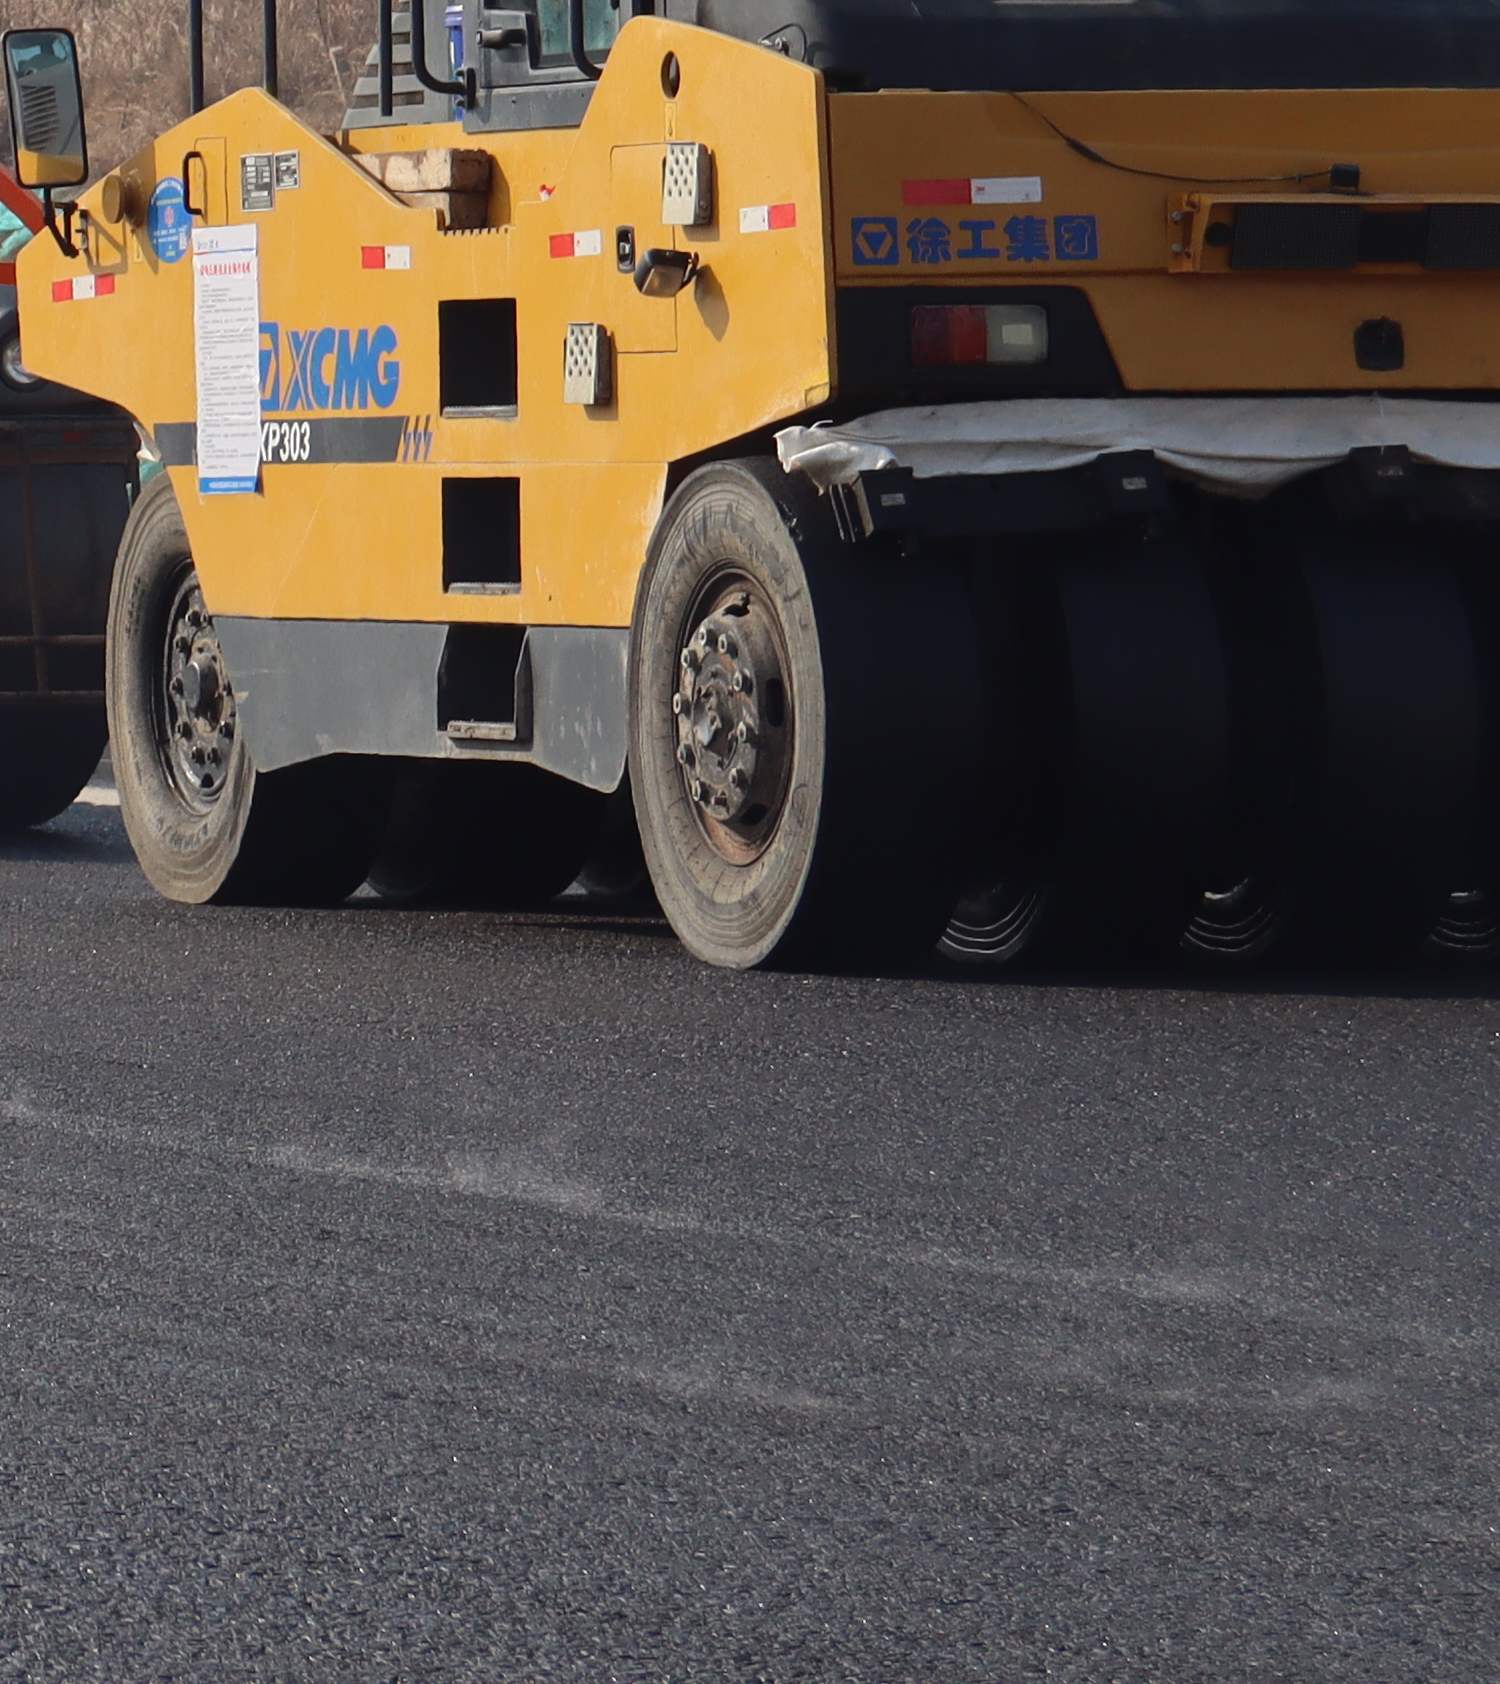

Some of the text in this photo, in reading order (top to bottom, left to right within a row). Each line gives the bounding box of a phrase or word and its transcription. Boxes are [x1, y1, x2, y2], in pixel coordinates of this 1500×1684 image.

[906, 216, 1098, 263] 徐工集团
[283, 325, 400, 411] XCMG
